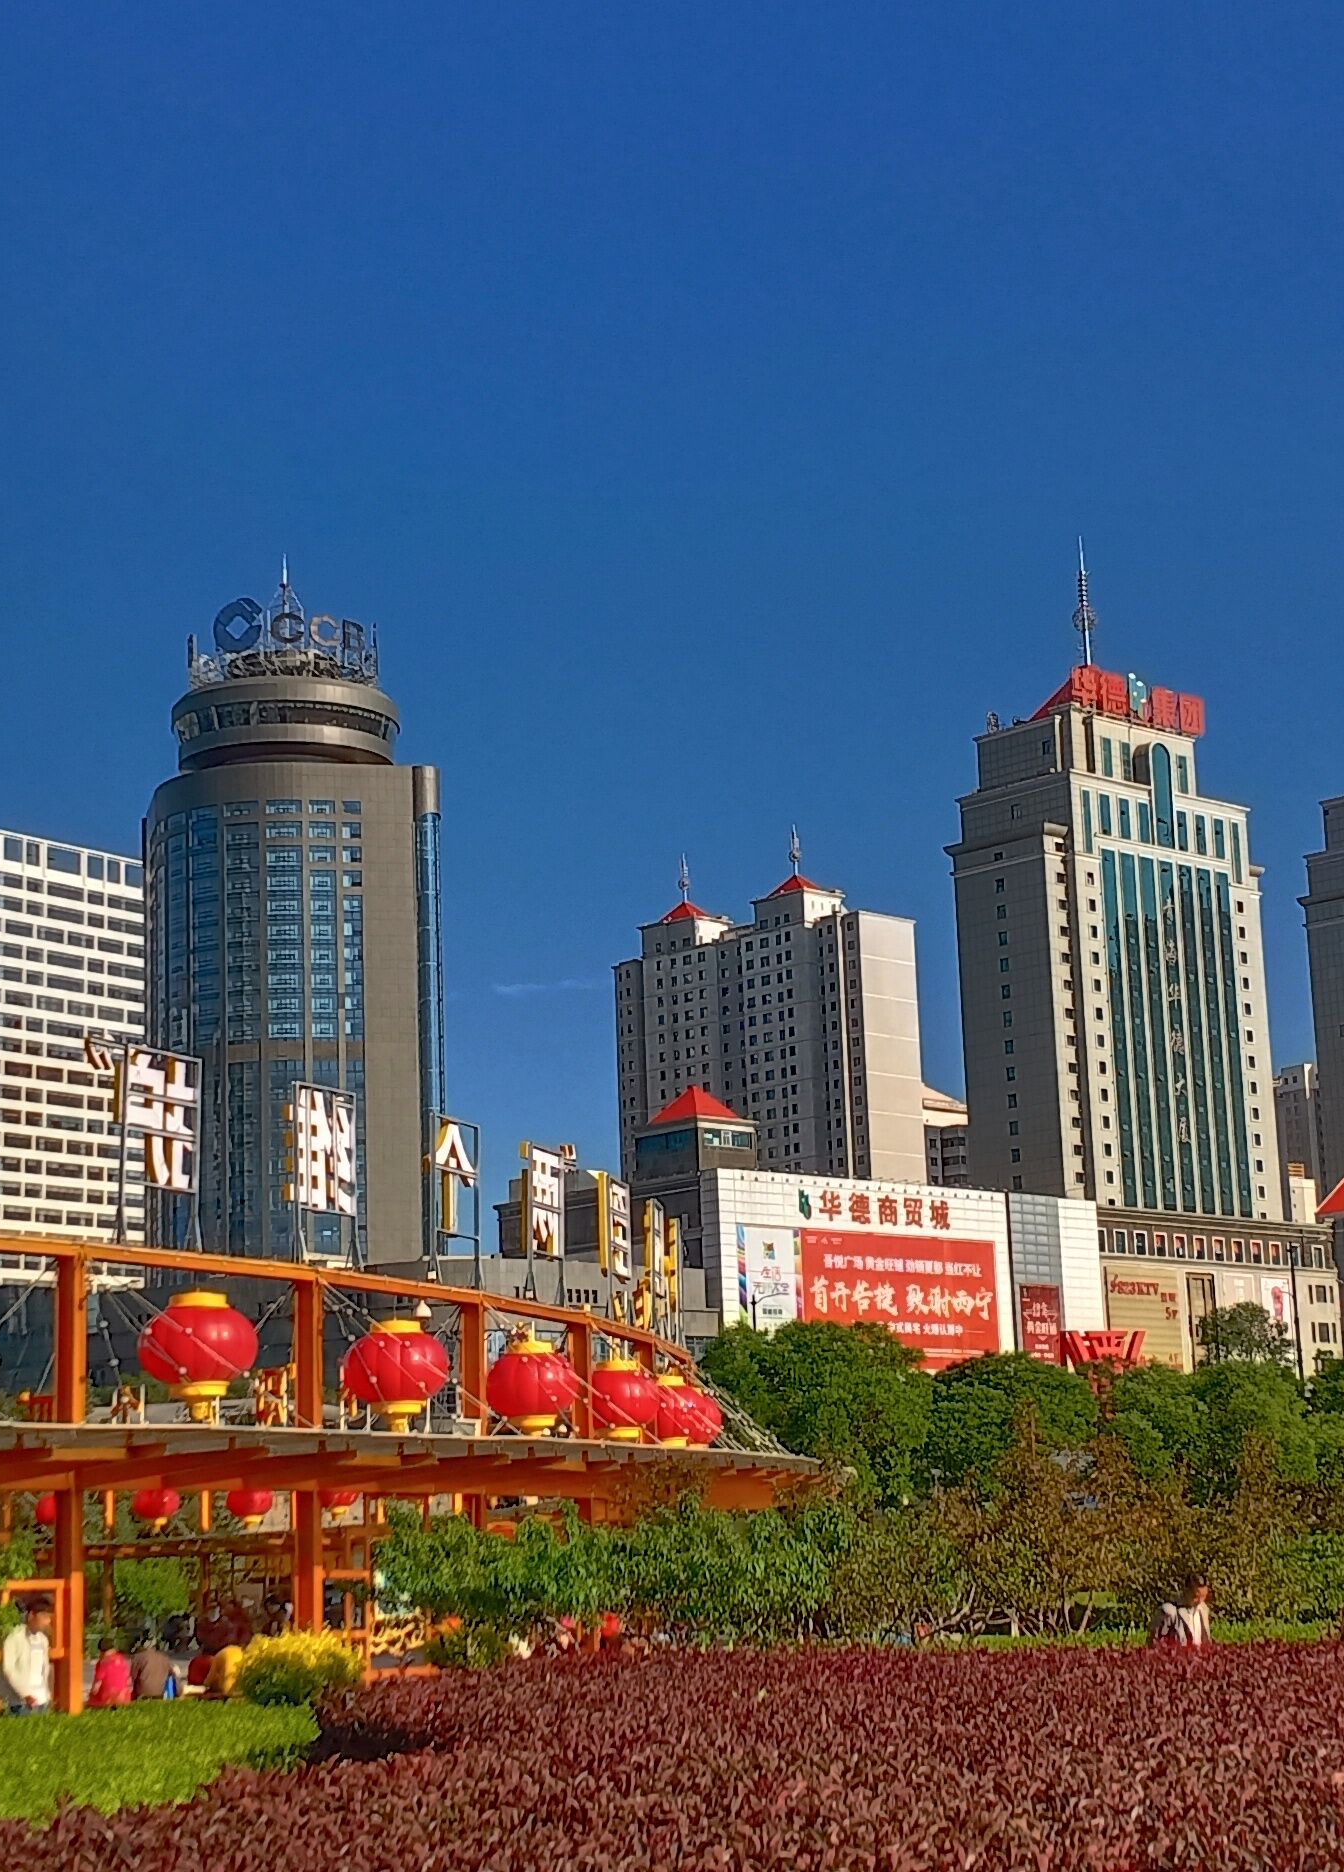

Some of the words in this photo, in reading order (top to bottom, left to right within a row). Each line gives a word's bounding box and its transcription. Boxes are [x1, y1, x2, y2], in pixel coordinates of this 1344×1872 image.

[271, 612, 365, 650] CCB
[1072, 665, 1205, 735] 华德集团
[819, 1190, 951, 1230] 华德商贸城
[810, 1276, 899, 1316] 首开告捷
